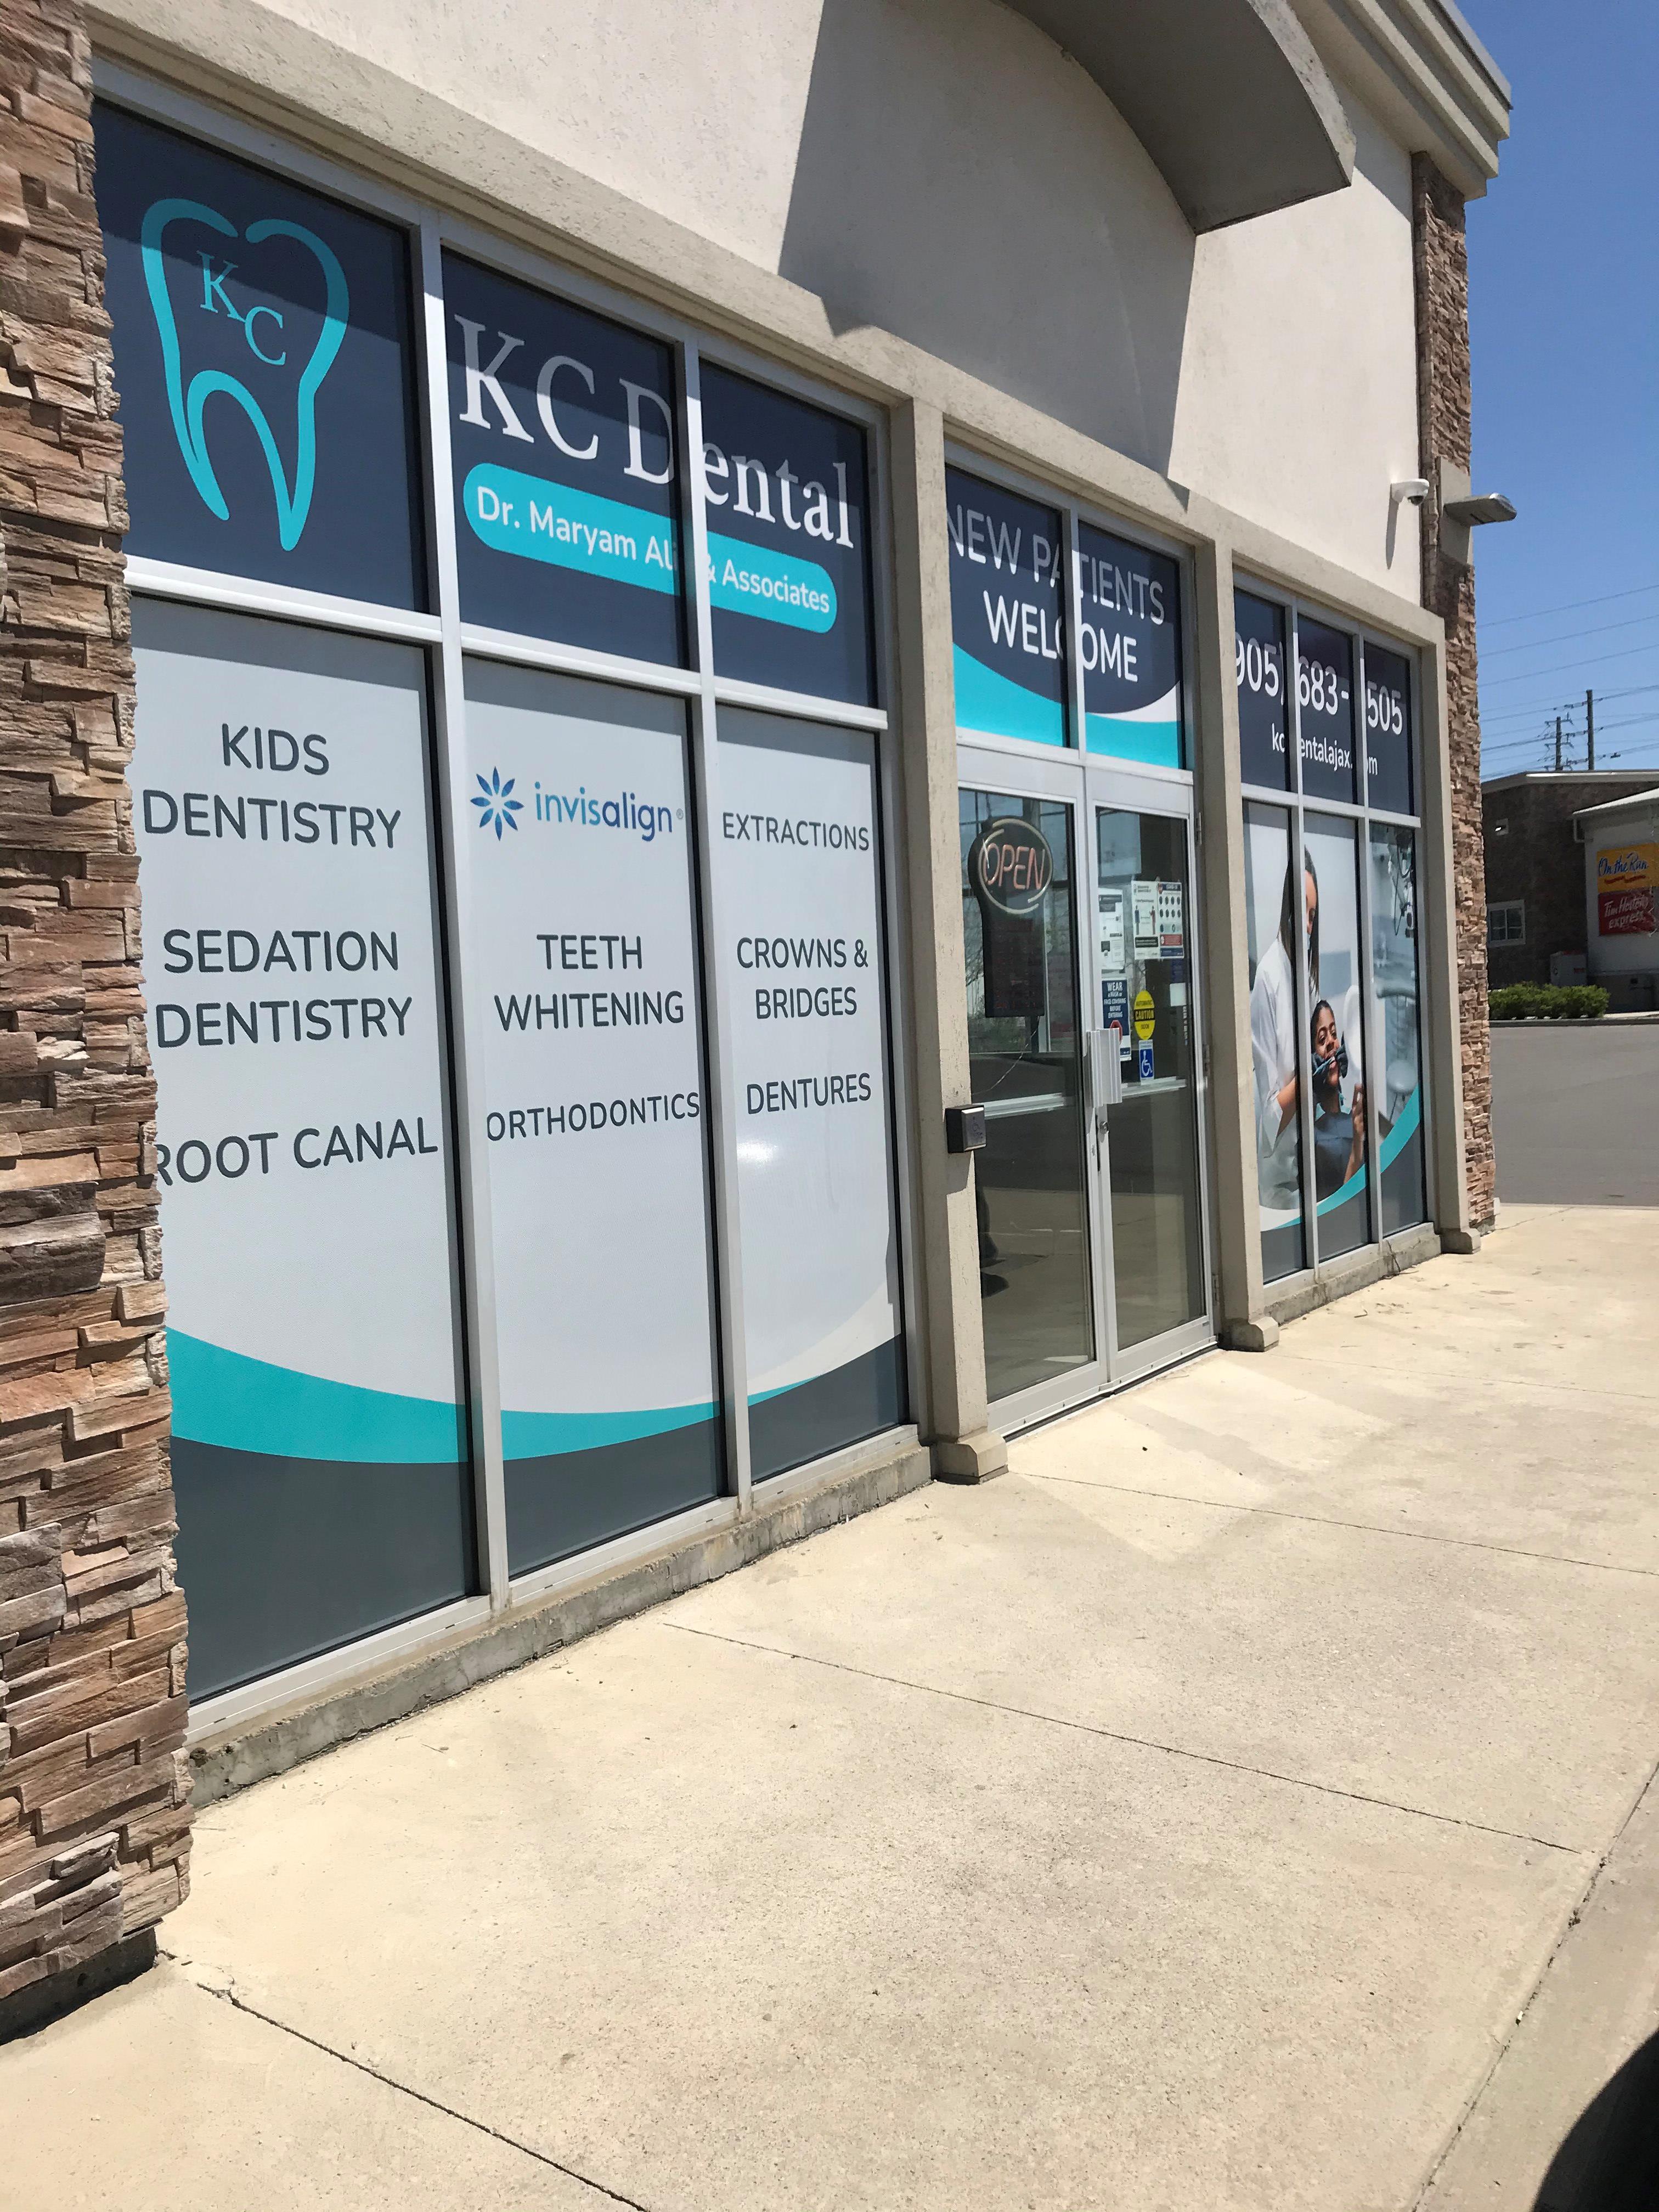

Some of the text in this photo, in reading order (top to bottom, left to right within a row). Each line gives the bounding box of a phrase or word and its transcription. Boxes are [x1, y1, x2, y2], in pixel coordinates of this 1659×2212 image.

[454, 314, 854, 549] KC Dental
[477, 486, 520, 528] Dr.
[531, 500, 636, 561] Maryam
[722, 559, 830, 614] Associates
[947, 504, 1021, 574] NEW
[1299, 656, 1403, 735] 683-505
[222, 723, 329, 775] KIDS
[1272, 723, 1378, 776] kcentalajax.m
[143, 789, 401, 848] DENTISTRY
[723, 812, 870, 851] EXTRACTIONS
[983, 843, 1045, 889] OPEN
[1598, 851, 1648, 877] On the Run
[1604, 900, 1618, 918] Tim
[163, 929, 398, 973] SEDATION
[537, 934, 642, 969] TEETH
[737, 937, 868, 968] CROWNS &
[755, 986, 857, 1019] BRIDGES
[1107, 982, 1123, 991] WEAR
[156, 997, 412, 1048] DENTISTRY
[494, 991, 684, 1031] WHITENING
[1135, 1010, 1154, 1020] CAUTION
[747, 1073, 871, 1114] DENTURES
[487, 1092, 699, 1141] ORTHODONTICS
[156, 1117, 438, 1186] ROOT CANAL
